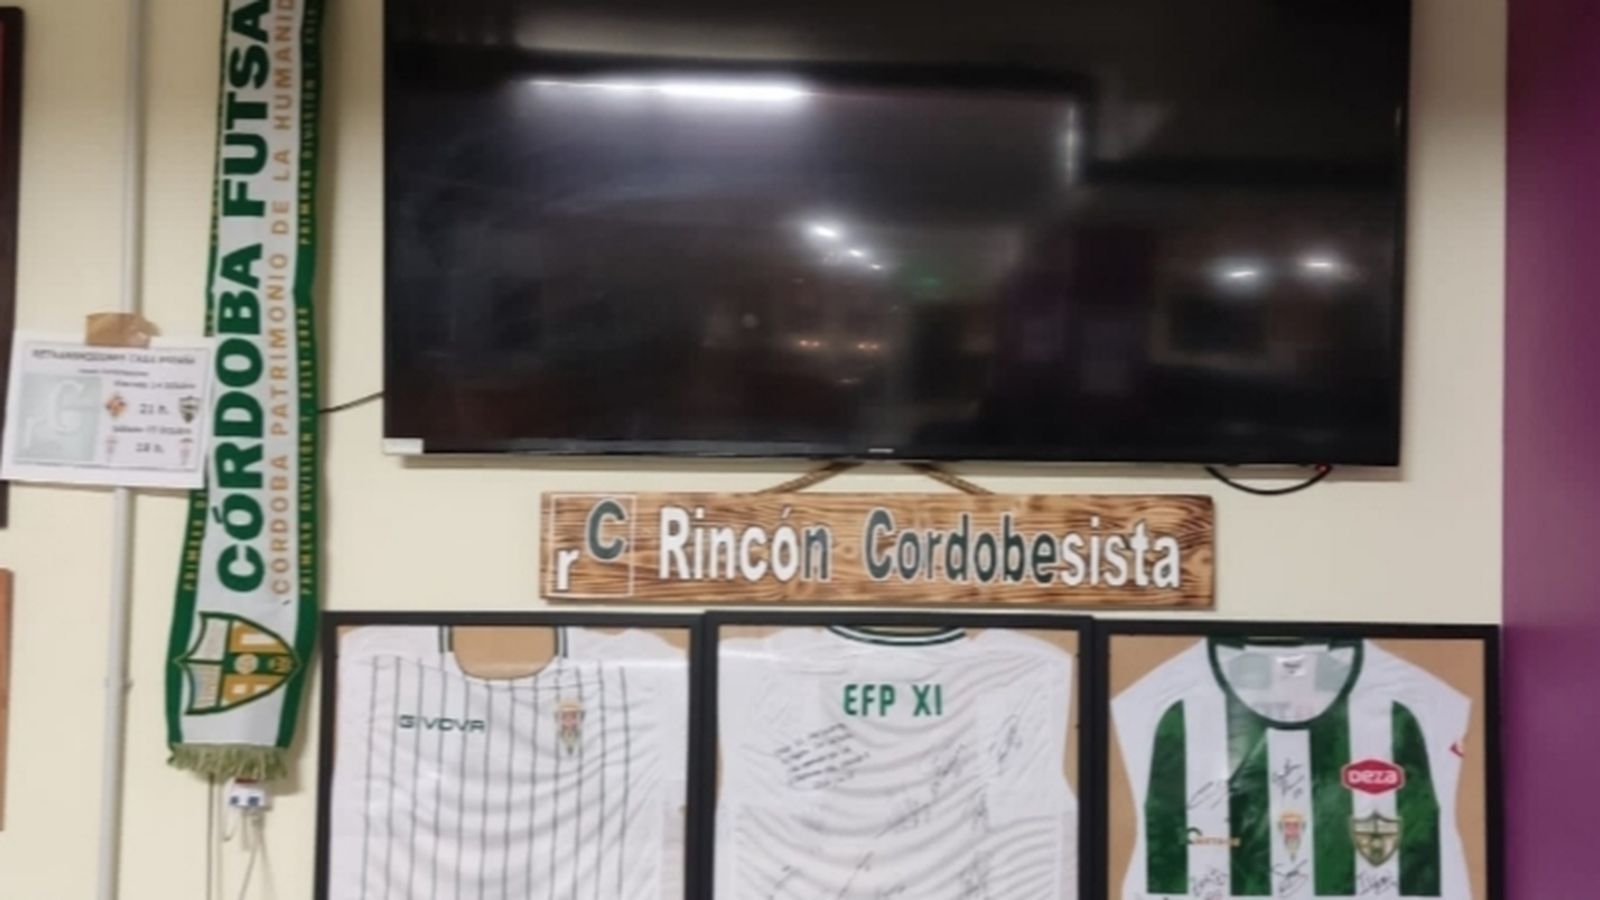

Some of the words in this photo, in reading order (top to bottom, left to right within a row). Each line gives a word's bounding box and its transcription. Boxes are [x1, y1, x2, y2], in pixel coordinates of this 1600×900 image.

[273, 149, 291, 181] LA
[272, 199, 290, 235] DE
[266, 253, 291, 436] PATRIMONIO
[212, 243, 265, 592] CÓRDOBA
[270, 455, 291, 596] CORDOBA
[657, 504, 831, 583] Rincón
[863, 508, 1181, 588] Cordobesista
[842, 683, 897, 717] EFP
[911, 683, 944, 717] XI
